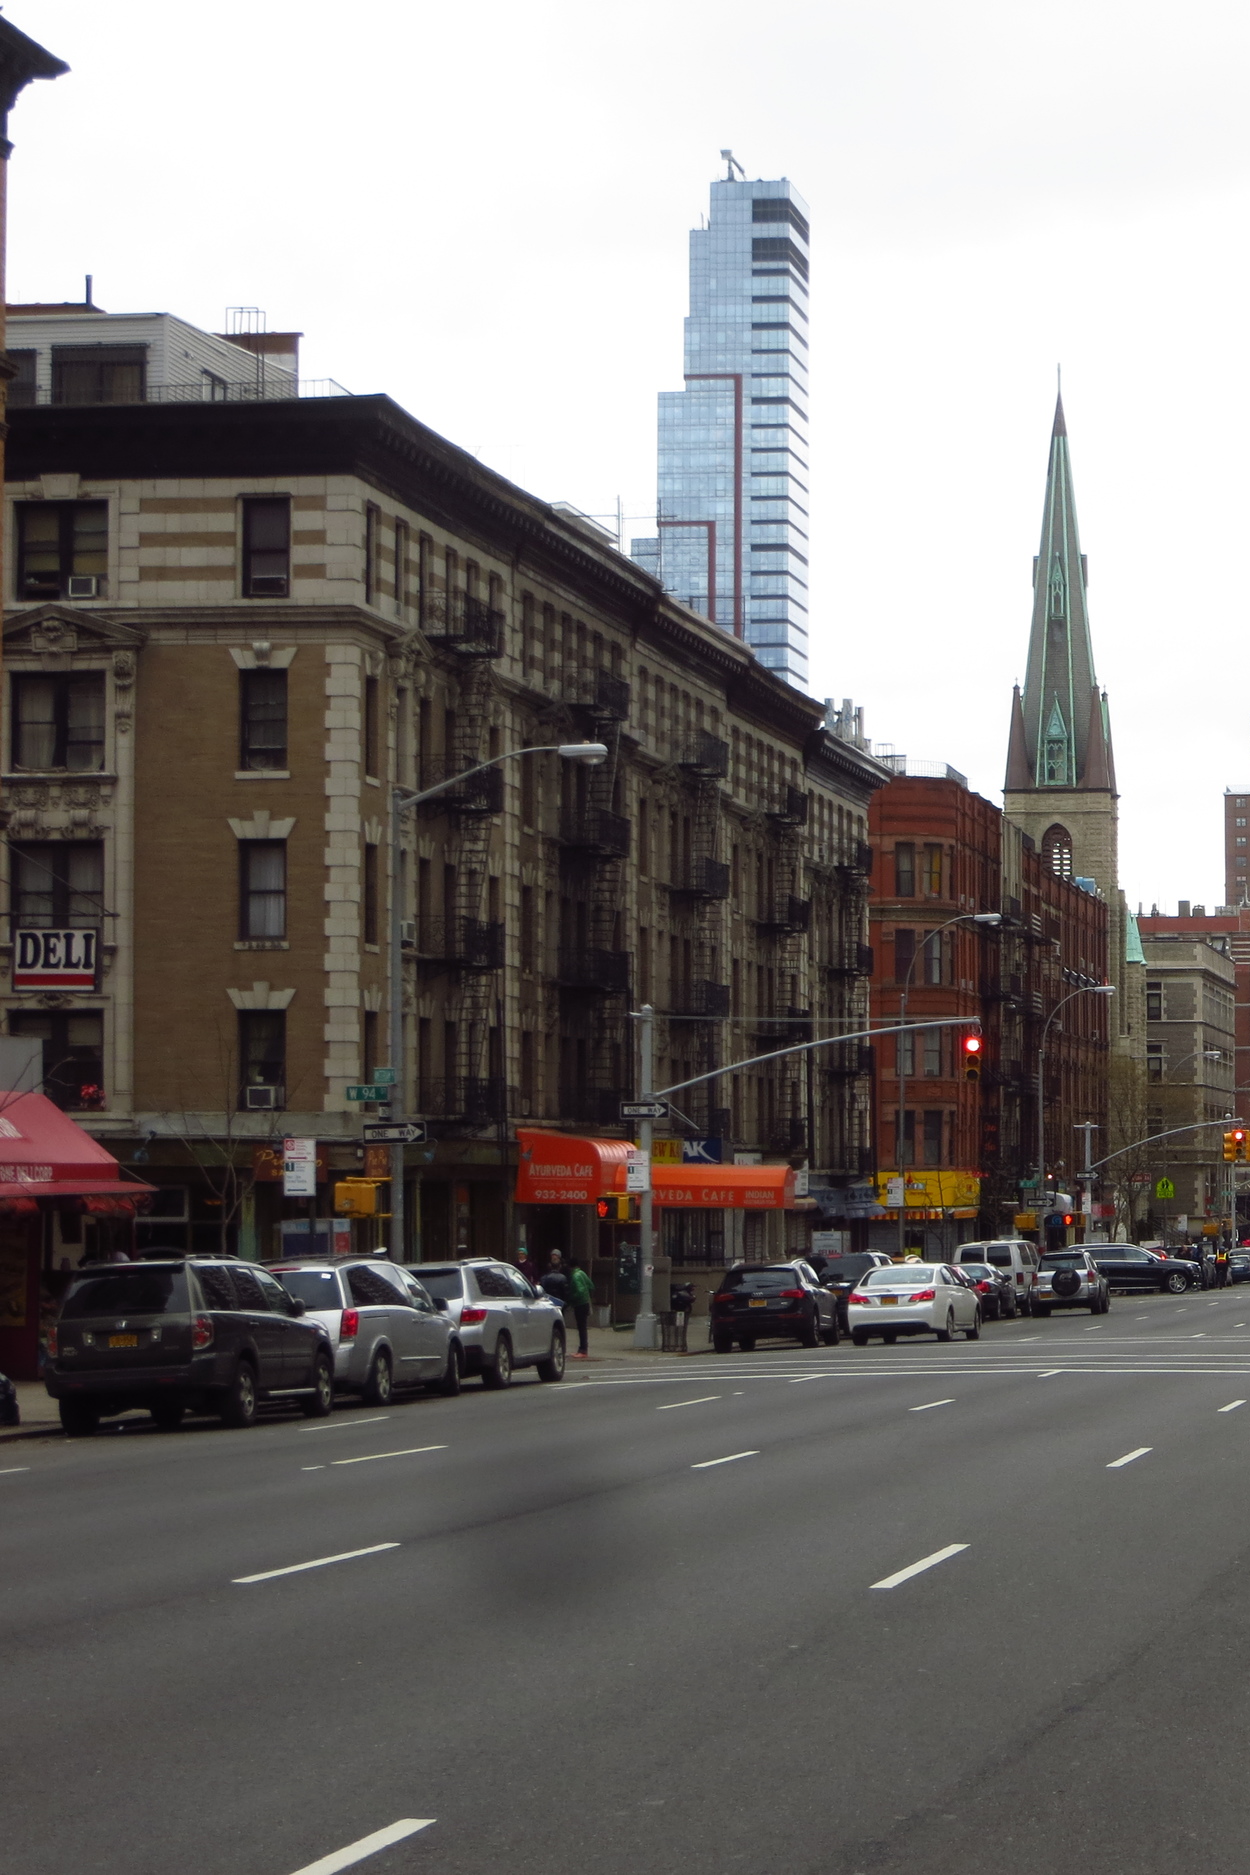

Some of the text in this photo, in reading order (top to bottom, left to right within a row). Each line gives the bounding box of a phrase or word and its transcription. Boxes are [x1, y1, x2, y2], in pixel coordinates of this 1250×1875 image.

[18, 932, 95, 969] DELI
[348, 1087, 358, 1100] W
[361, 1087, 377, 1100] 94
[371, 1128, 417, 1139] ONE WAY
[529, 1163, 573, 1177] AYURVEDA
[534, 1189, 588, 1200] 932-2400
[652, 1188, 775, 1202] RVEDA CAFE INDIAN
